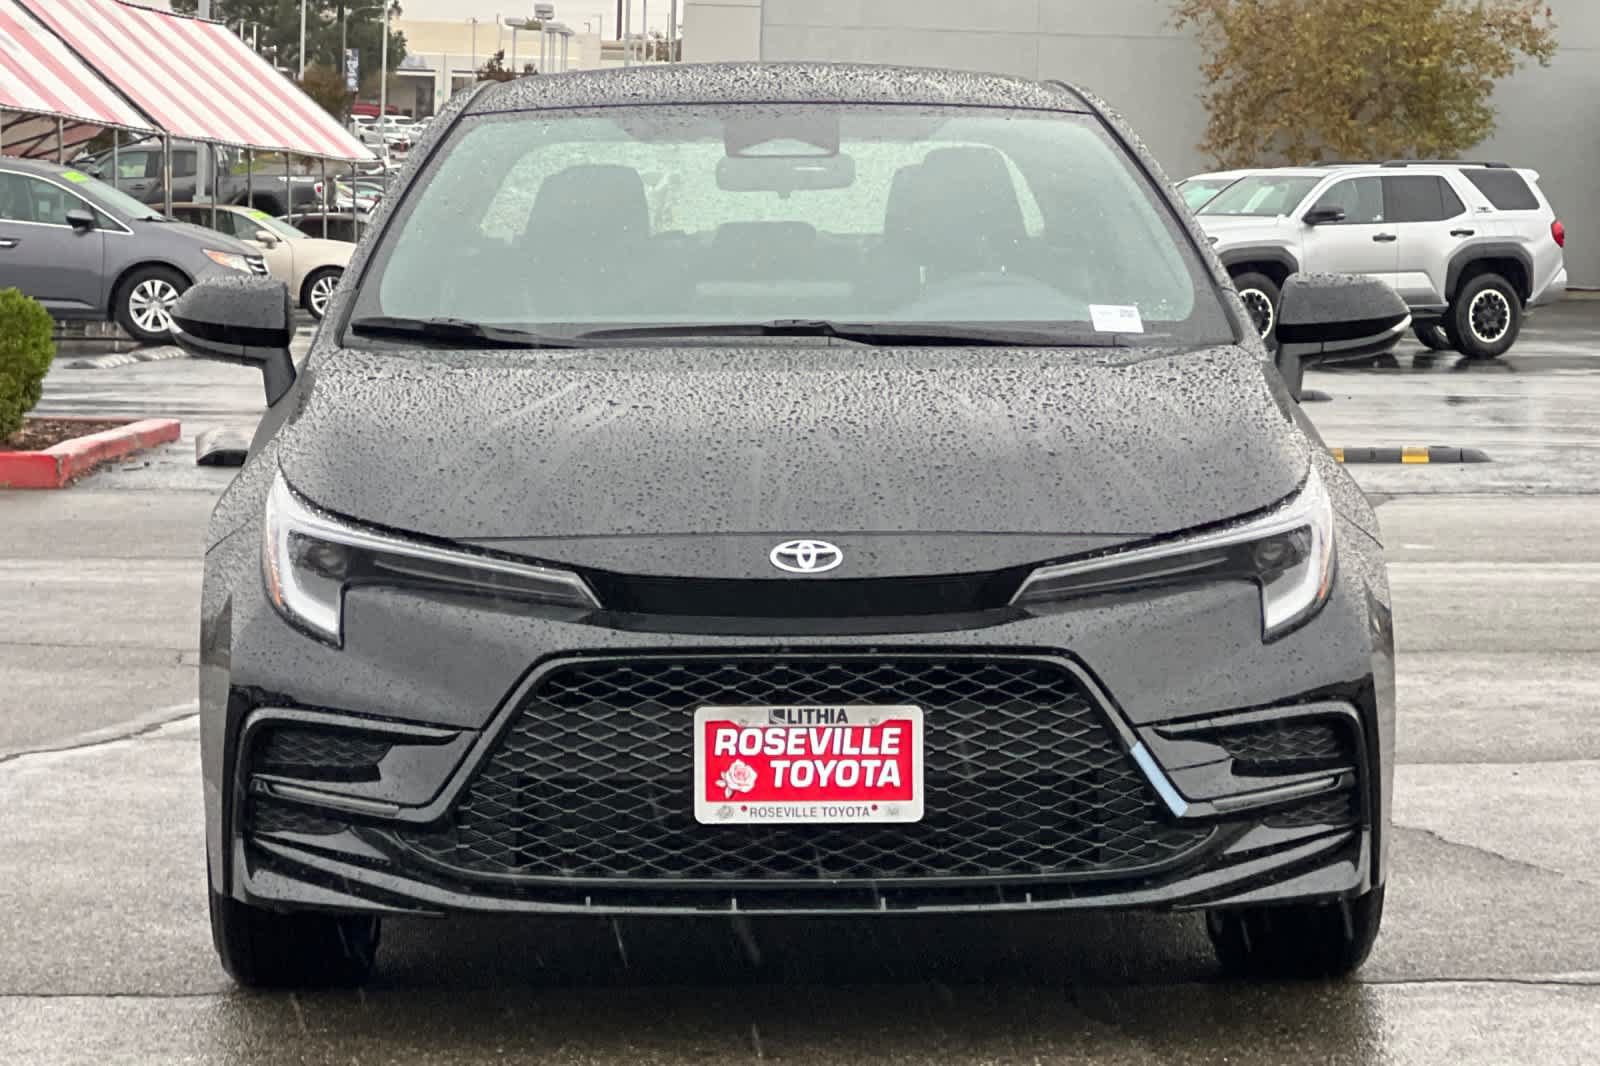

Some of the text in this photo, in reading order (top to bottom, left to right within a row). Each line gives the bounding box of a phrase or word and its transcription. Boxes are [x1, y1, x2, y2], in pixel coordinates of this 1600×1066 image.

[787, 709, 848, 724] LITHIA
[714, 727, 901, 756] ROSEVILLE
[770, 759, 901, 788] TOYOTA
[750, 805, 870, 818] ROSEVILLE TOYOTA
